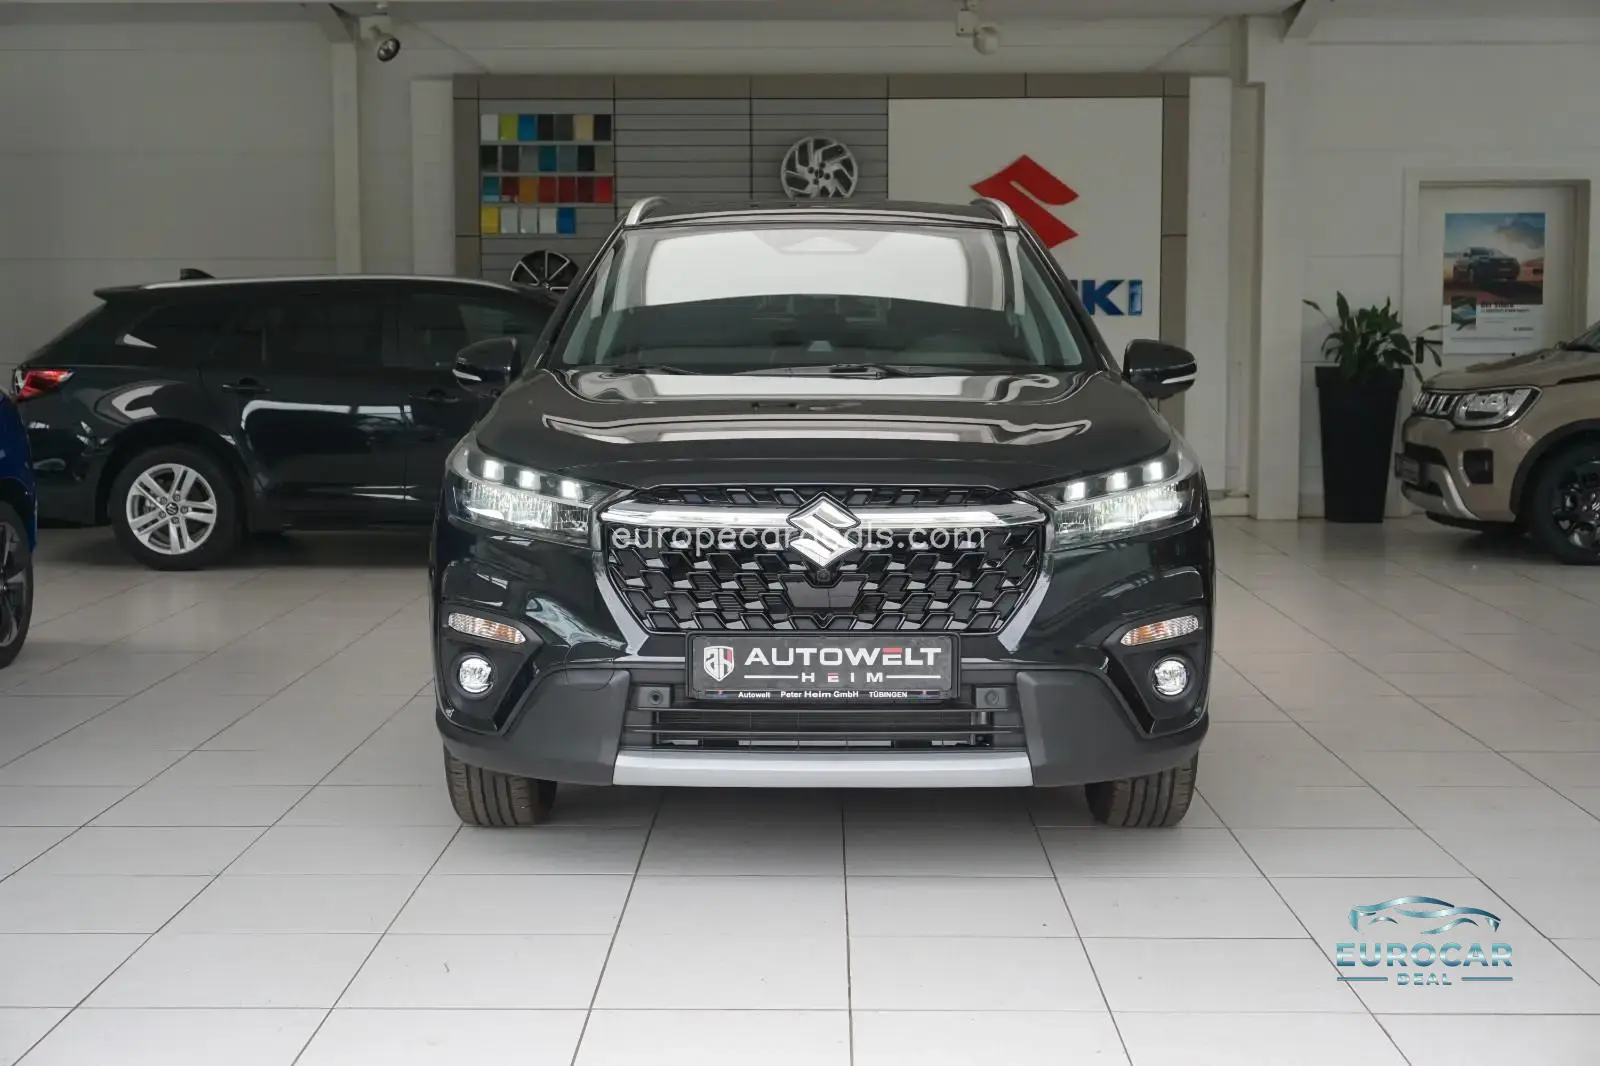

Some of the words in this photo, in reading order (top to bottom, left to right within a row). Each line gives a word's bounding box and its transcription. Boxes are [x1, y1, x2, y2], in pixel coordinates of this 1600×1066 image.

[1067, 279, 1143, 316] KI
[743, 647, 942, 666] AUTOWELT
[800, 672, 884, 683] HEIM
[738, 691, 771, 699] Autowelt
[780, 691, 802, 699] Peter
[804, 691, 831, 699] Heim
[833, 690, 859, 699] GmbH
[869, 690, 908, 699] TÜBINGEN
